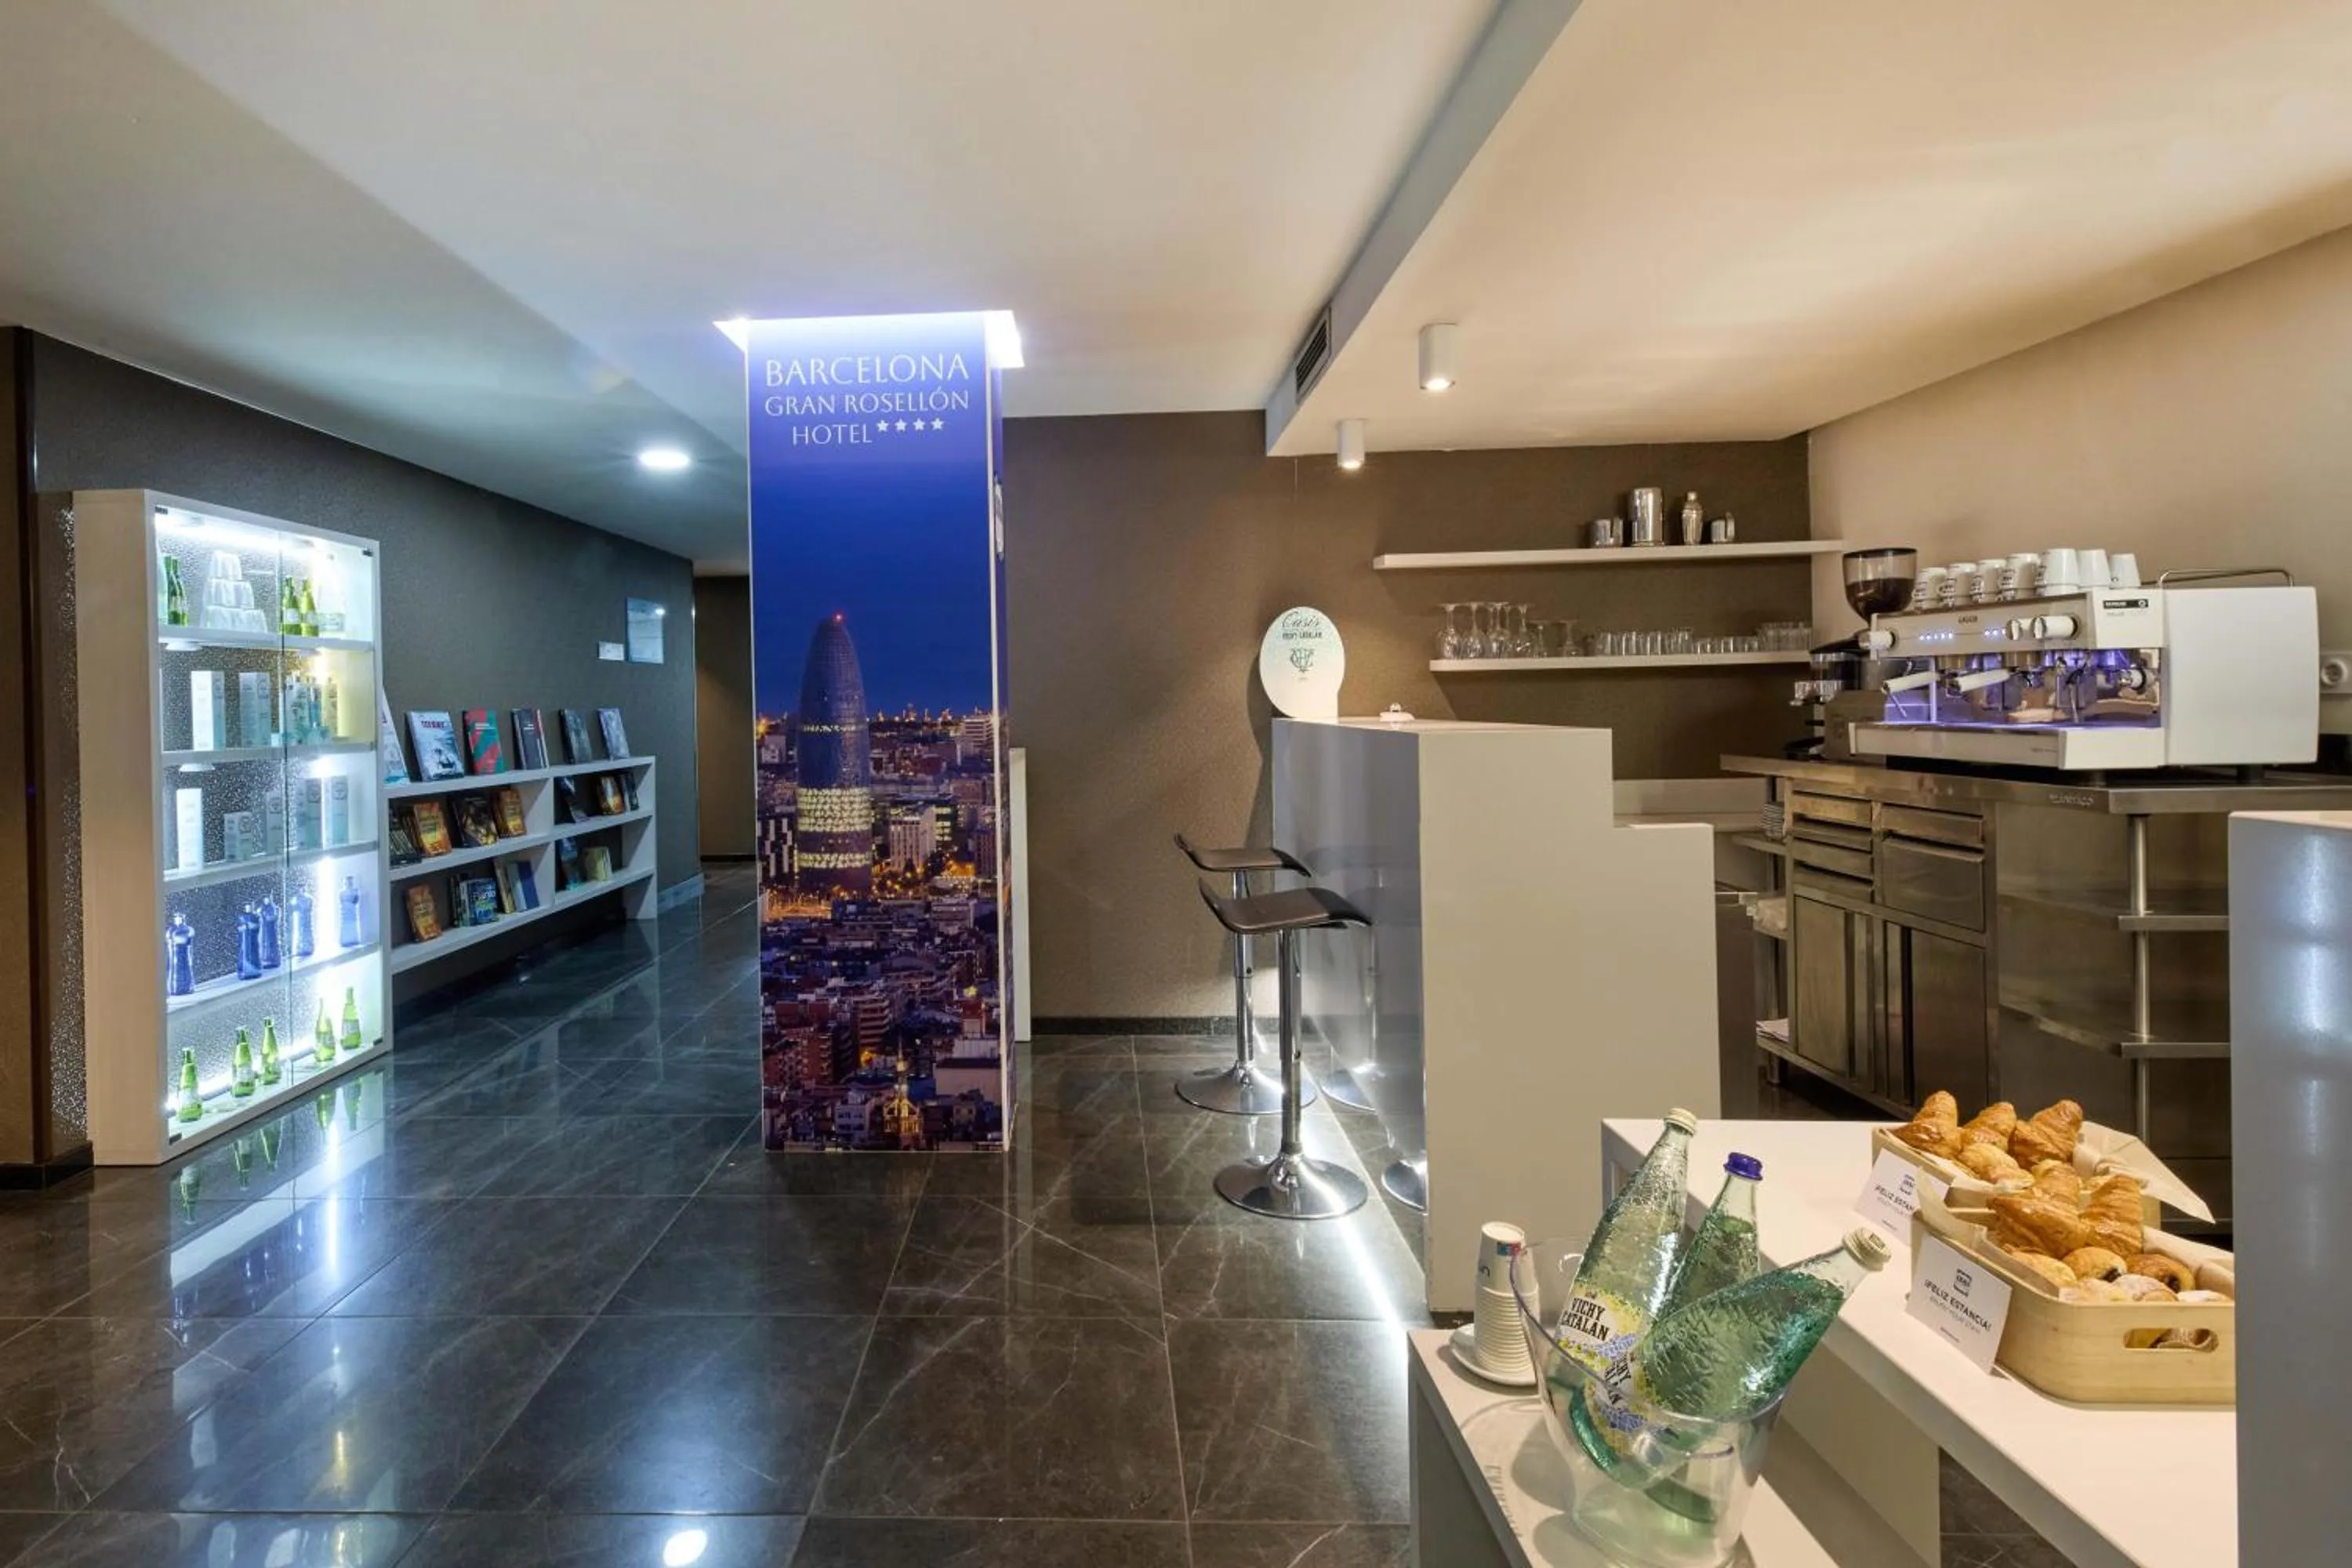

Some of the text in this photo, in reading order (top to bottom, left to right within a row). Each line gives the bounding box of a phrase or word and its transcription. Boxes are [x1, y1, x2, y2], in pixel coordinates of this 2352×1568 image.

[765, 353, 969, 387] BARCELONA
[764, 385, 969, 416] GRAN ROSELLÓN
[792, 423, 873, 445] HOTEL
[1560, 1310, 1610, 1341] CATALAN
[1570, 1298, 1606, 1322] VICHY
